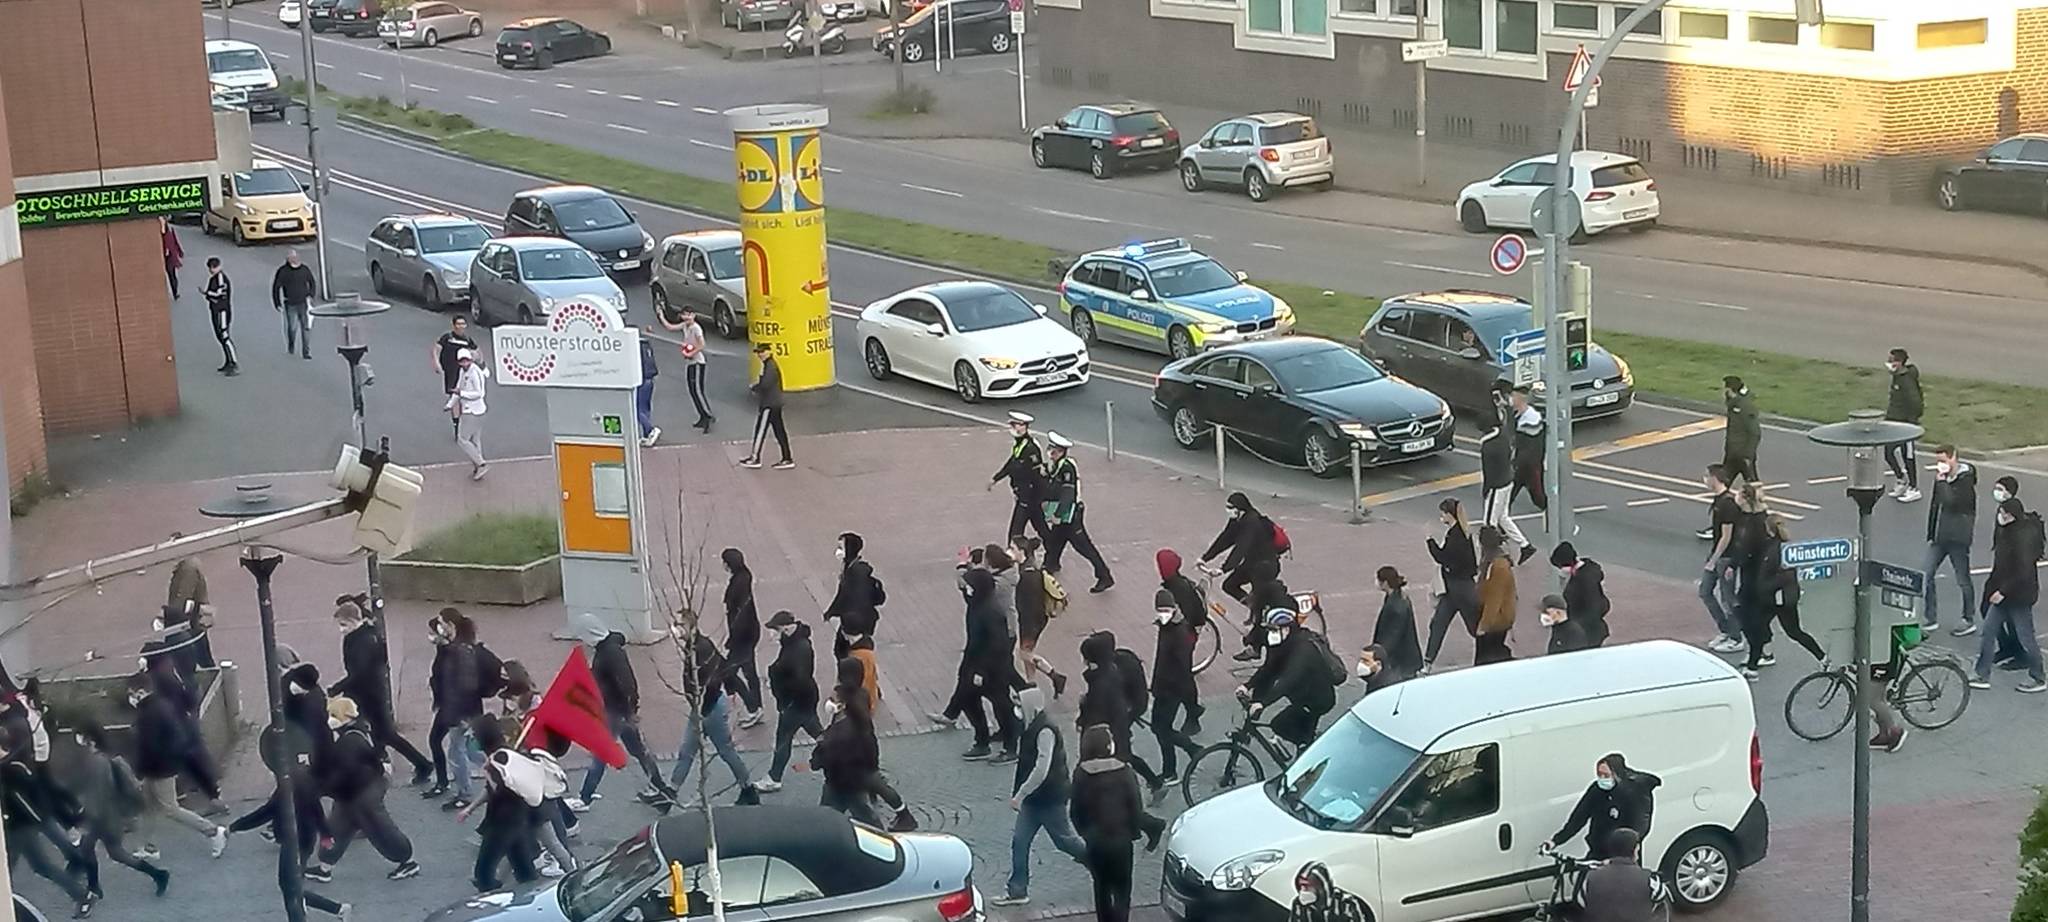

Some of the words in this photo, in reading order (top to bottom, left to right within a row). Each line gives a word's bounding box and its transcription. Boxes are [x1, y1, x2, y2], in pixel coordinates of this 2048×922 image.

[1127, 308, 1155, 324] POLIZEI
[500, 333, 622, 352] münsterstraße
[775, 343, 789, 356] 51
[1787, 543, 1848, 562] Münsterstr.
